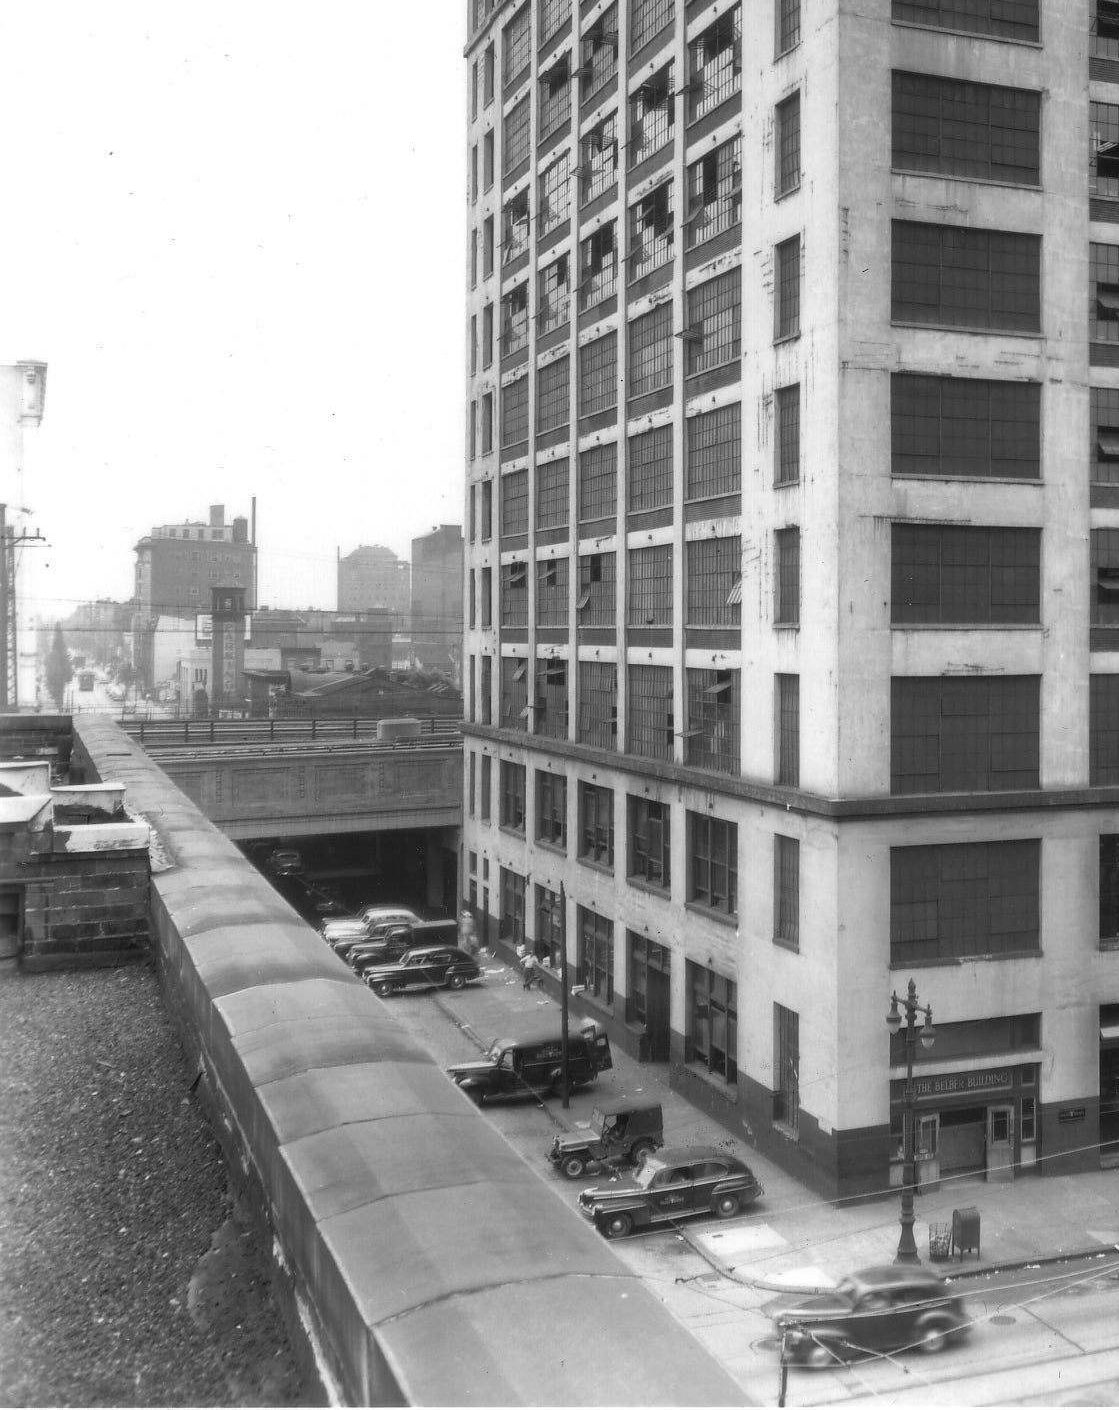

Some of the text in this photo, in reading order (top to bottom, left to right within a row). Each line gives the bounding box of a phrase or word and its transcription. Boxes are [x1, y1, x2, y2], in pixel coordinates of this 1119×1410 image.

[917, 1072, 1008, 1093] THE BELBER BUILDING
